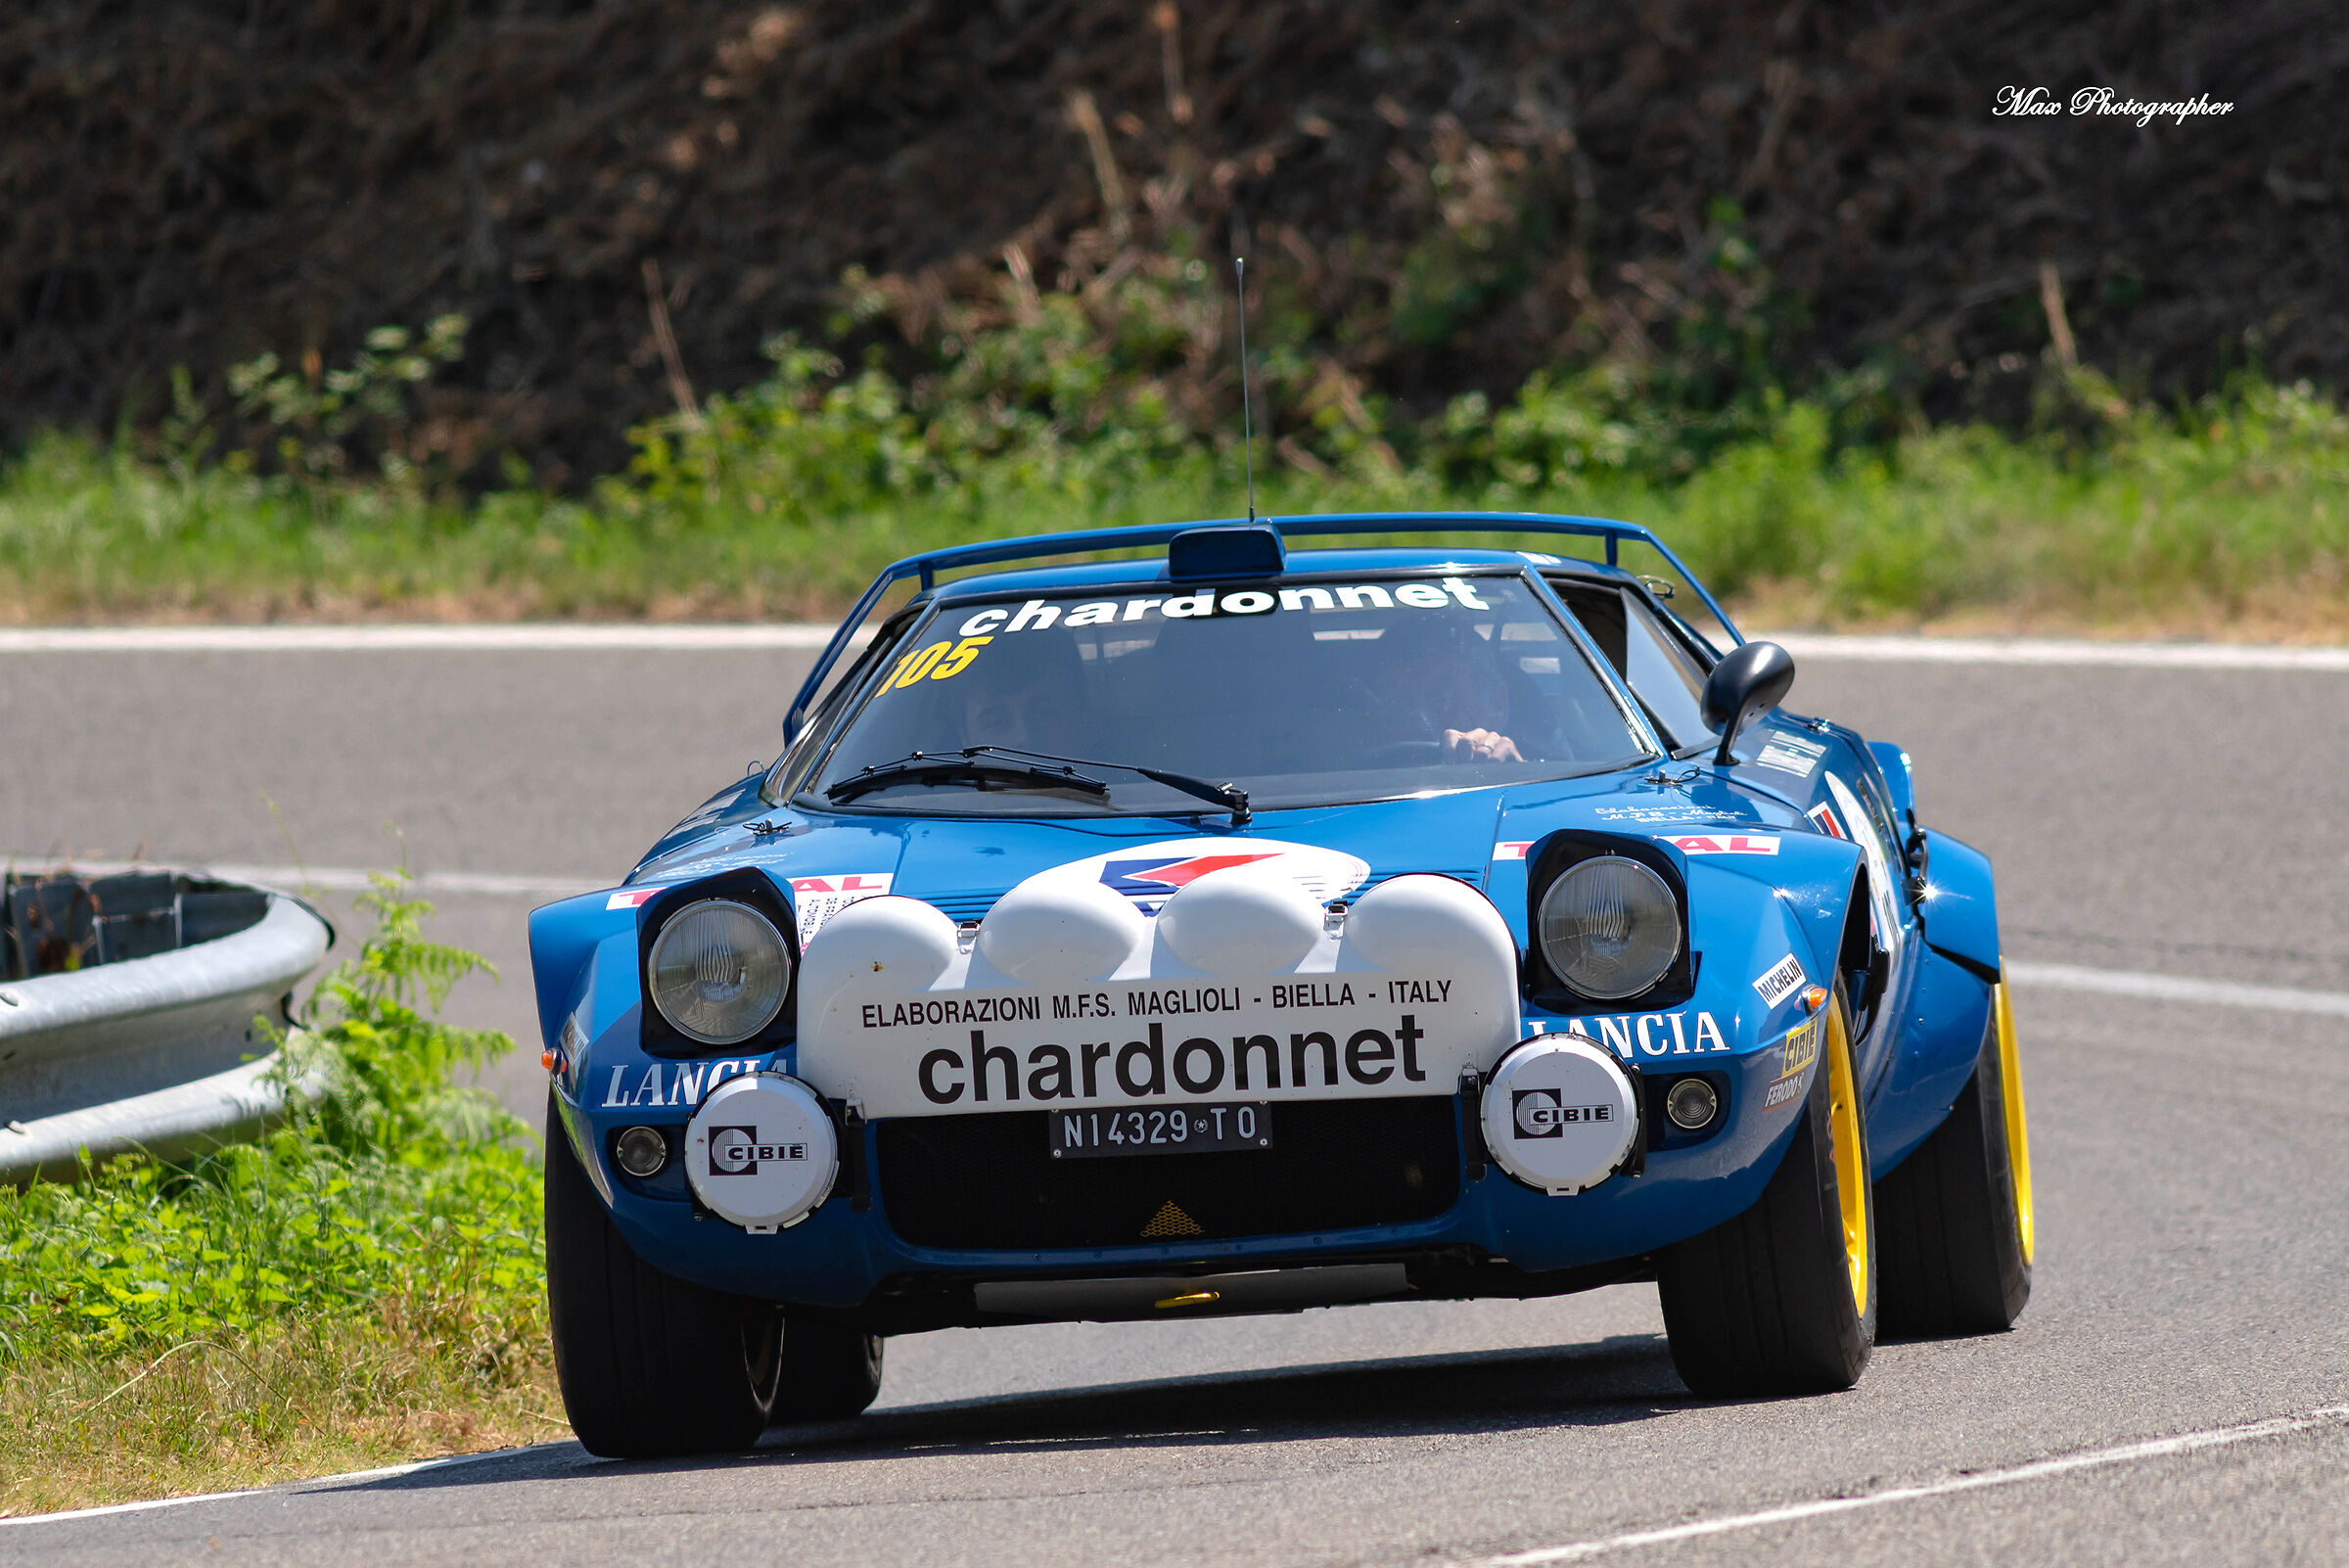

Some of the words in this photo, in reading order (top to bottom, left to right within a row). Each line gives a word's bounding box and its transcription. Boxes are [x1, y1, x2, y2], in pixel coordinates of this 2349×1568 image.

[957, 577, 1490, 638] chardonnet
[875, 636, 994, 698] 105
[862, 996, 1041, 1028] ELABORAZIONI
[1052, 992, 1116, 1019] M.F.S.
[1128, 988, 1241, 1016] MAGLIOLI
[1272, 983, 1356, 1009] BIELLA
[1388, 980, 1452, 1004] ITALY
[1757, 958, 1803, 1002] MICHELIN
[917, 1013, 1427, 1105] chardonnet
[1765, 1076, 1799, 1108] FERODO
